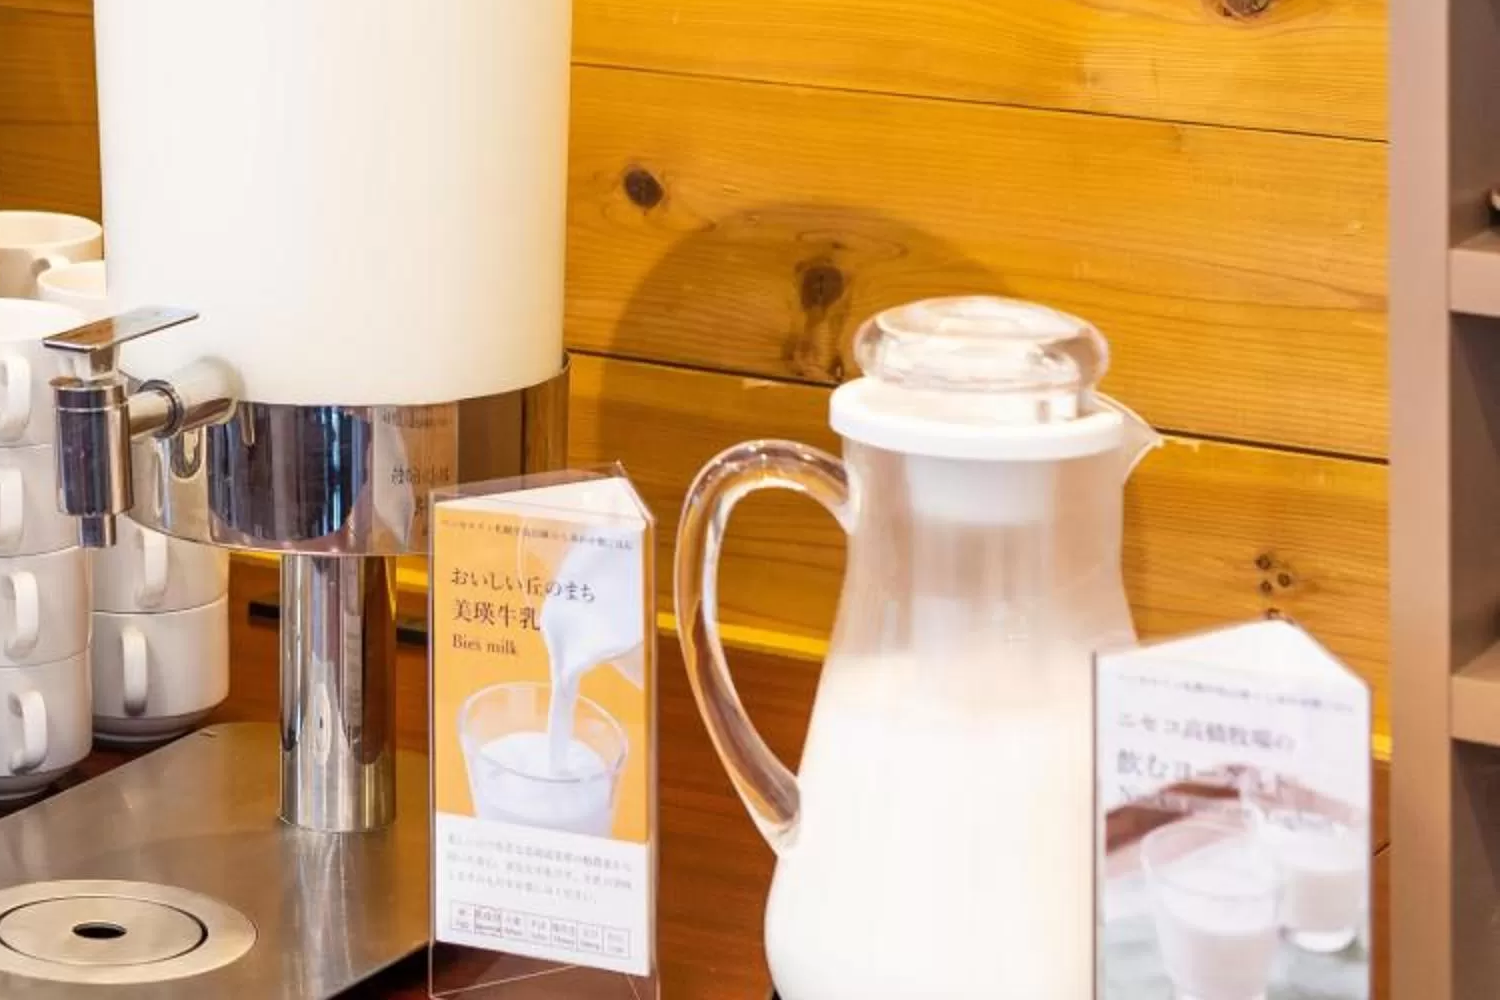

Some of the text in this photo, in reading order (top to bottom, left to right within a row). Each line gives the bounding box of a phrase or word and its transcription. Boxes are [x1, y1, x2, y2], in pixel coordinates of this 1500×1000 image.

[450, 567, 597, 604] おいしい丘のまち
[451, 598, 542, 632] 美瑛牛乳
